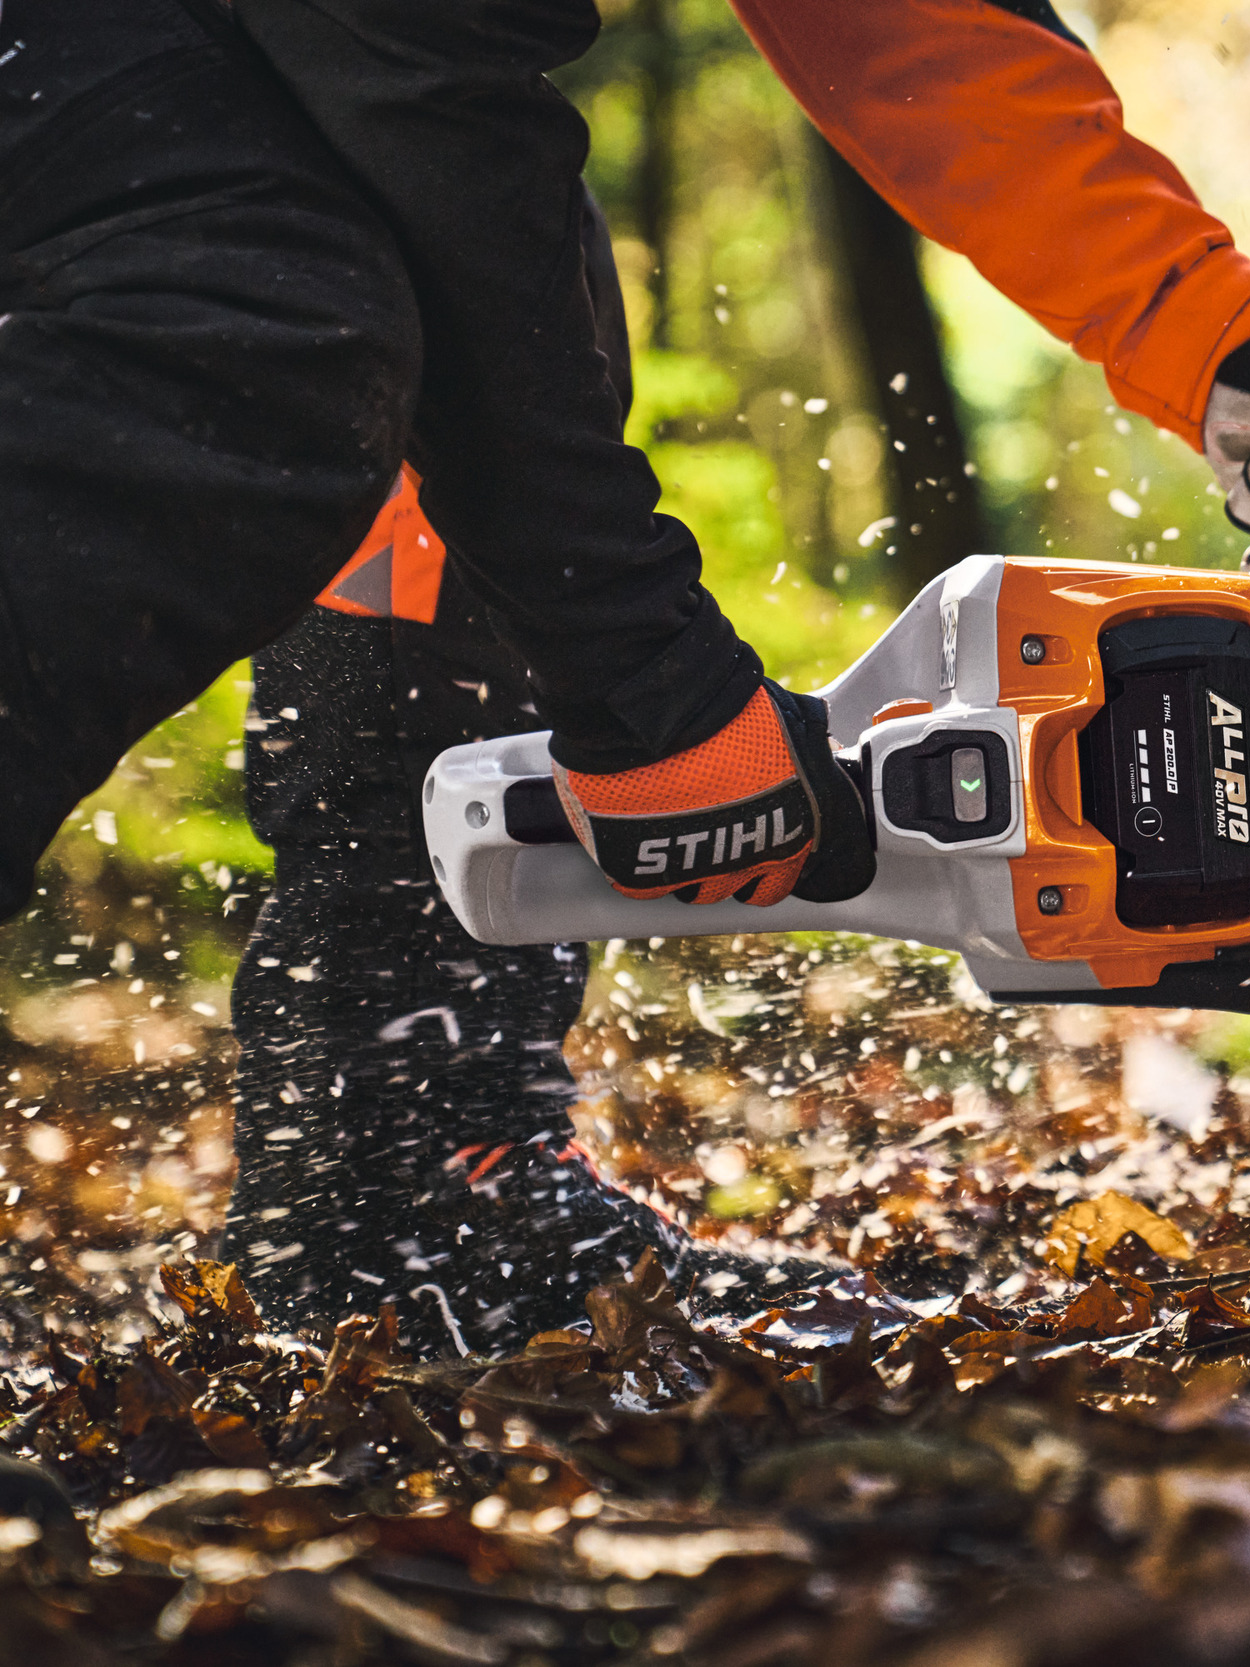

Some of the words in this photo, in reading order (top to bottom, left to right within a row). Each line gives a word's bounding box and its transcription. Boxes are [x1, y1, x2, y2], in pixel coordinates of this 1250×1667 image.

[1163, 694, 1171, 723] STIHL
[1165, 731, 1173, 746] AP
[1129, 763, 1137, 804] LITHIUM-ION
[1214, 781, 1225, 806] 40V
[1216, 808, 1227, 837] MAX
[634, 807, 803, 875] STIHL
